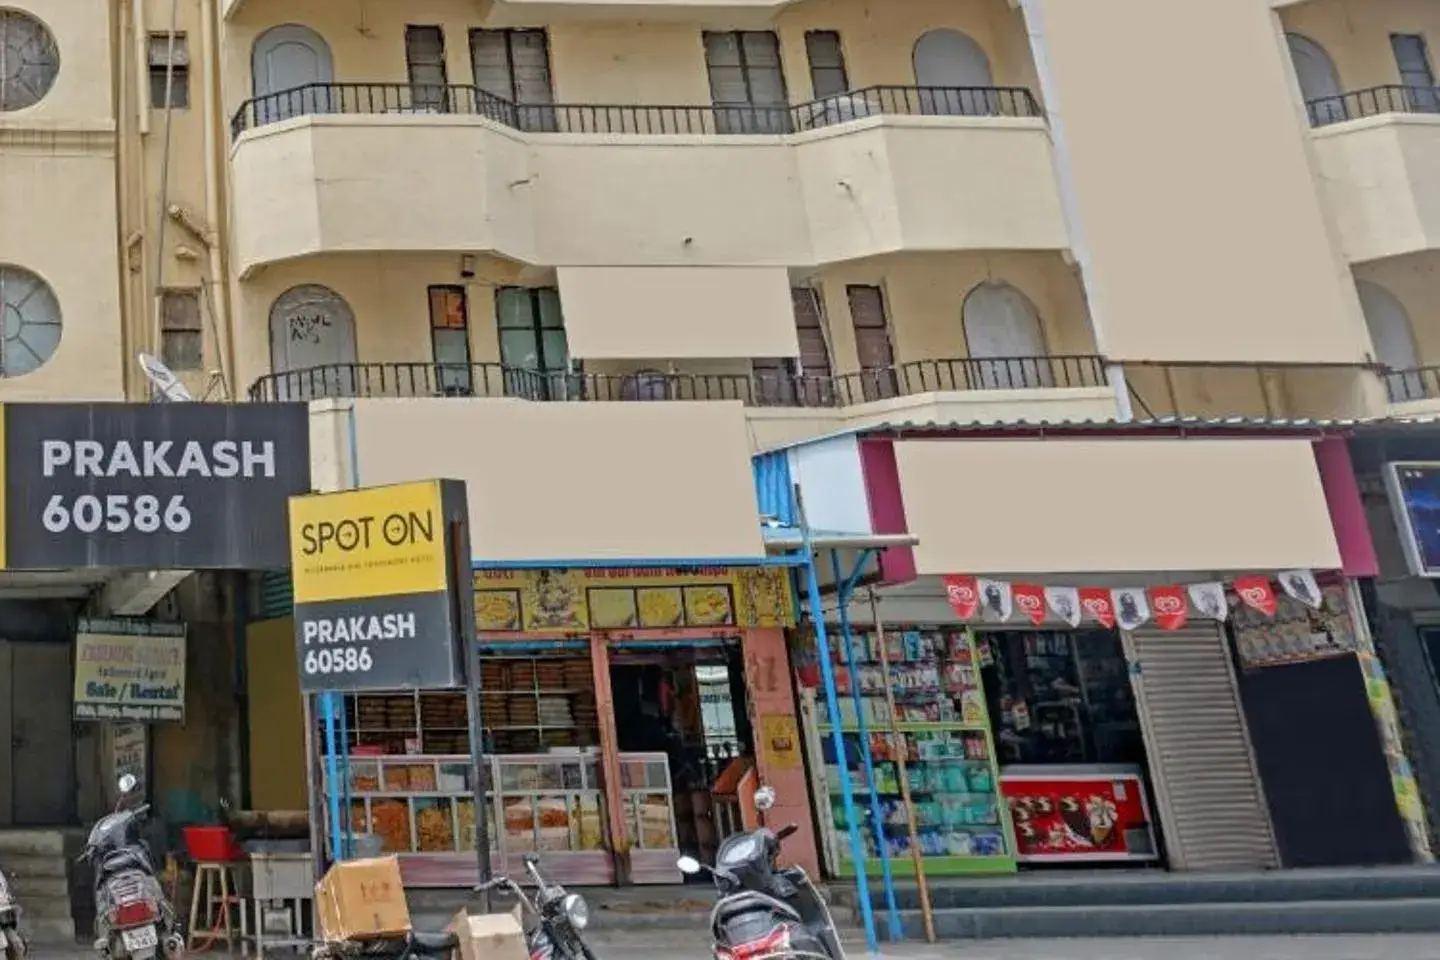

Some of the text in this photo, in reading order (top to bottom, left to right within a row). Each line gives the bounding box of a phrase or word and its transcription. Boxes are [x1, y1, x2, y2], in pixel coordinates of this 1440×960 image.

[42, 440, 276, 478] PRAKASH
[42, 494, 192, 533] 60586
[301, 509, 434, 556] SPOT ON
[303, 611, 417, 645] PRAKASH
[304, 646, 374, 674] 60586
